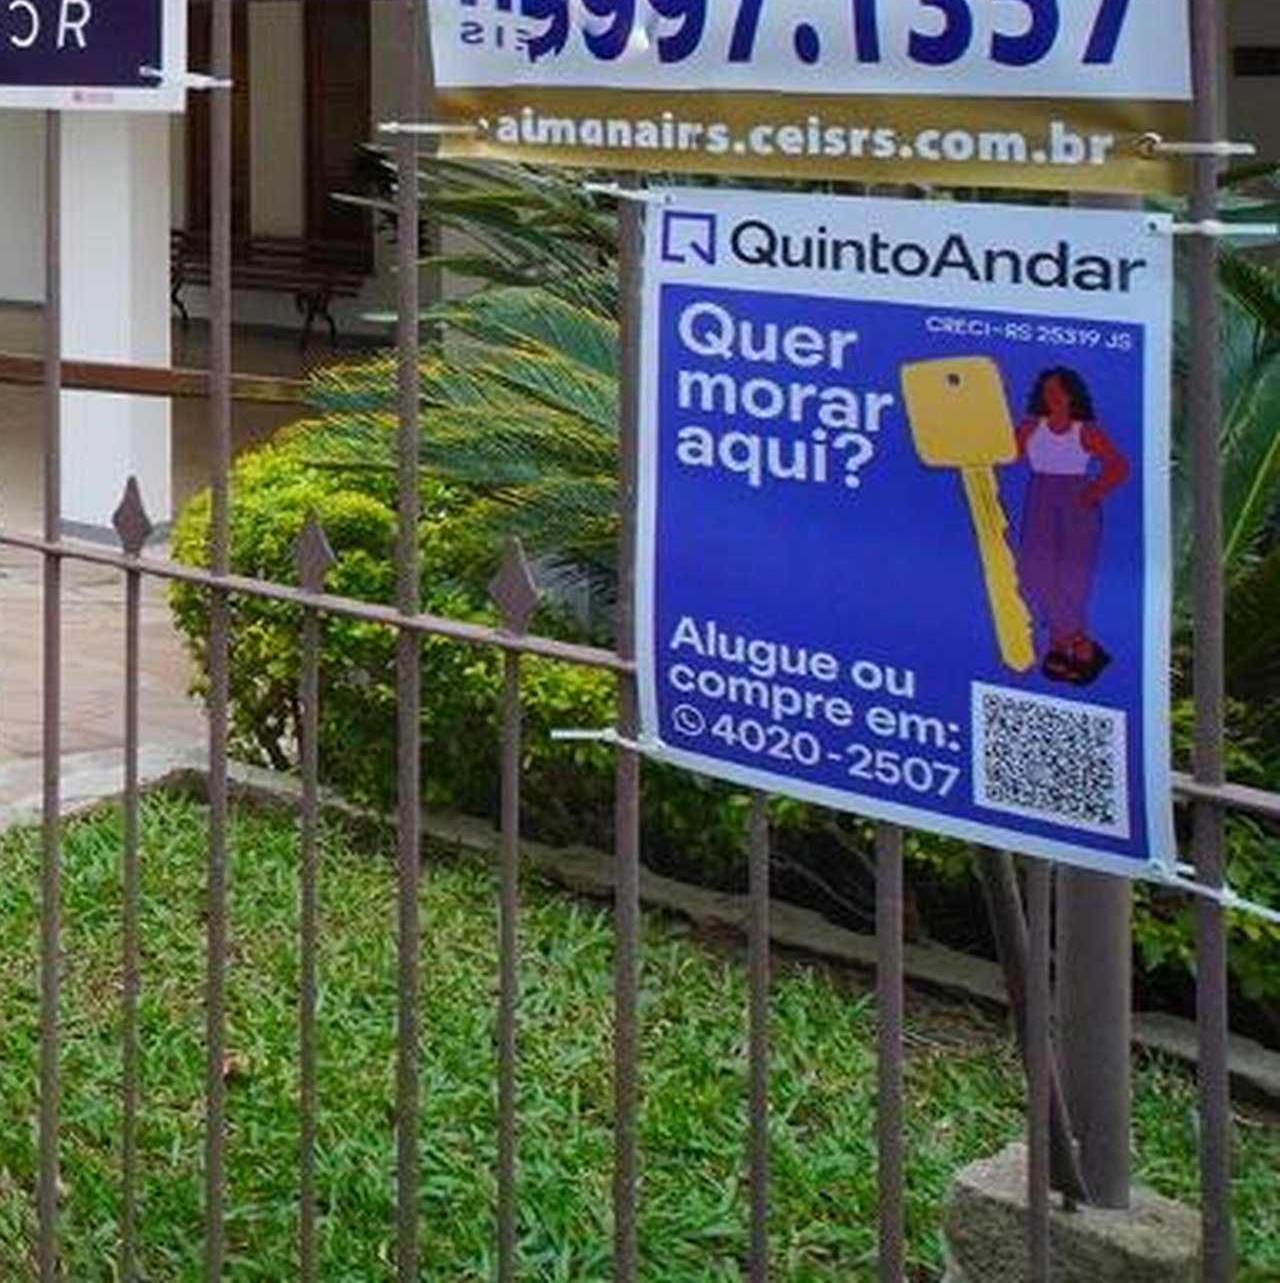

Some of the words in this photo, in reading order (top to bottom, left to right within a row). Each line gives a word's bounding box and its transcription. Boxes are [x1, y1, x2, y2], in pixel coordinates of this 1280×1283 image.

[730, 219, 1147, 293] QuintoAndar
[677, 301, 859, 370] Quer
[677, 368, 895, 433] morar
[676, 426, 876, 489] aqui?
[669, 616, 839, 681] Alugue
[851, 660, 915, 699] ou
[669, 663, 853, 727] compre
[865, 706, 960, 752] em:
